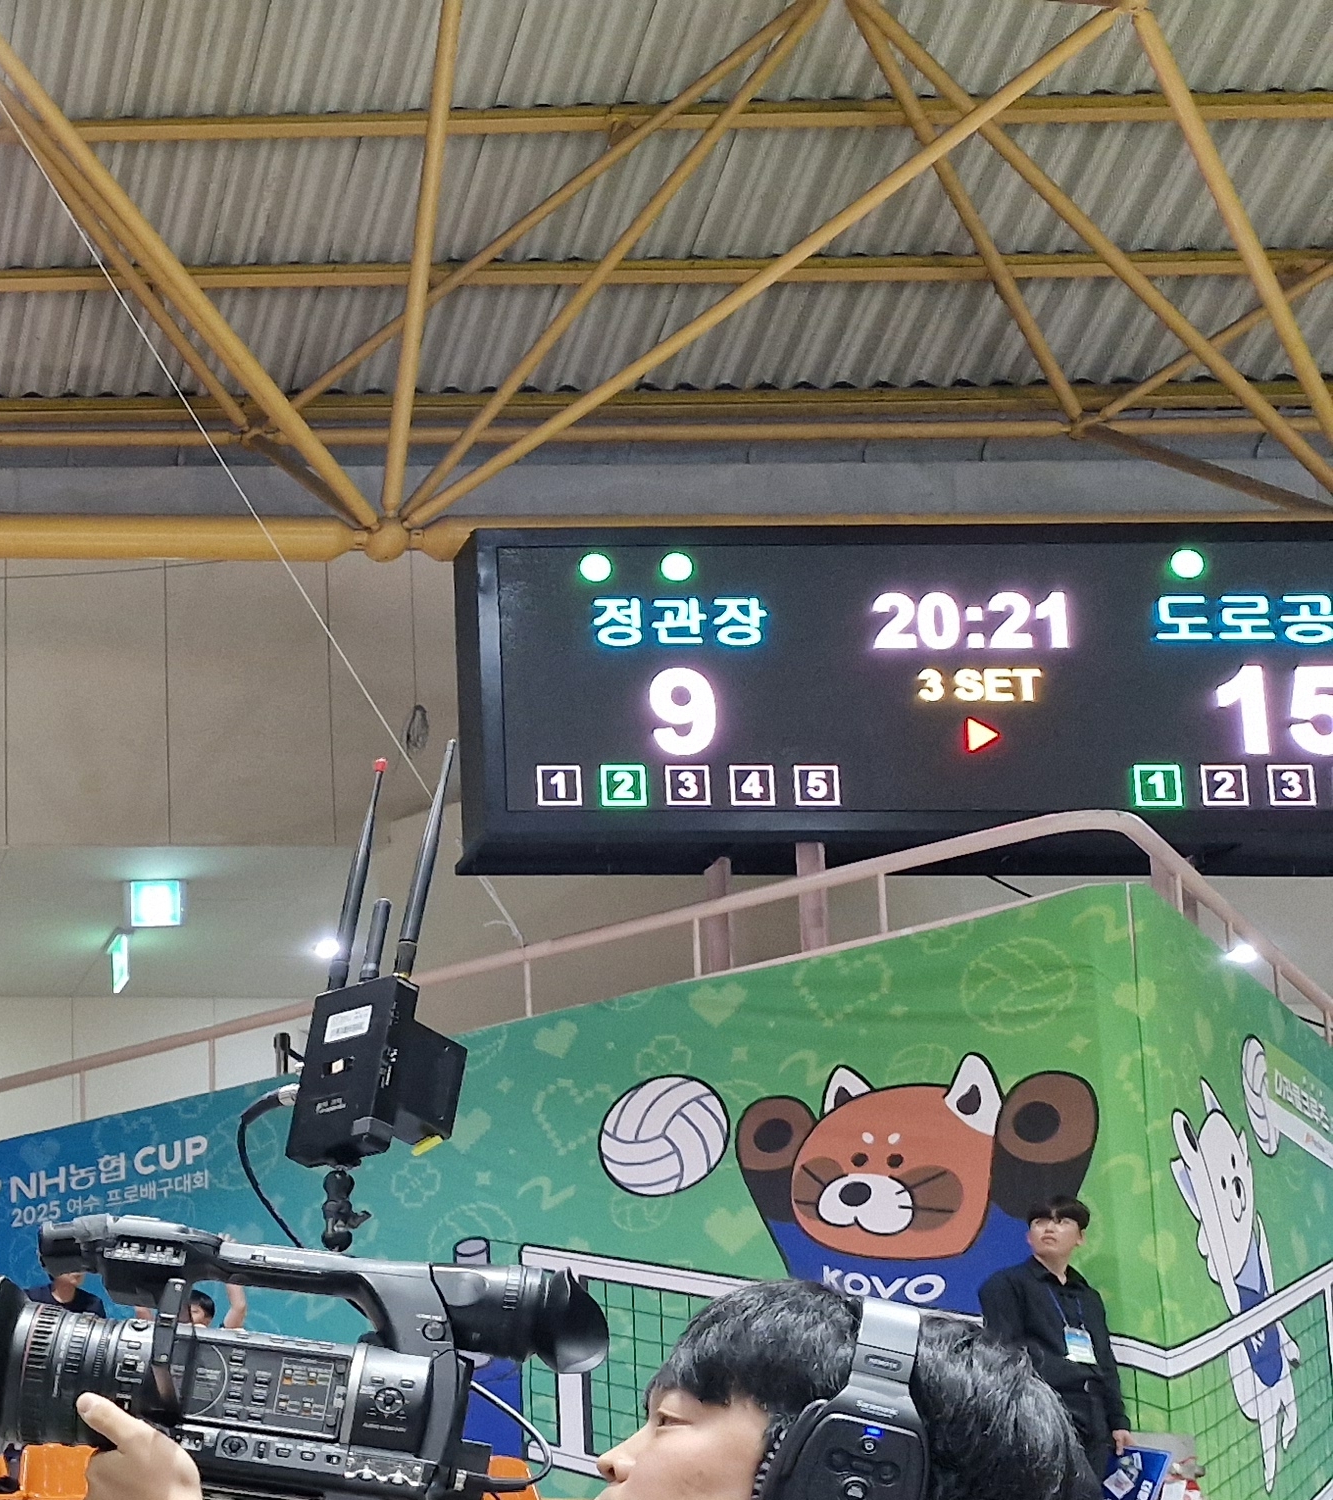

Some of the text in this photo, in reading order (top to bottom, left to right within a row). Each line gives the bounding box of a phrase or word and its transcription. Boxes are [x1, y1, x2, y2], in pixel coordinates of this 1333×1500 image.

[592, 596, 768, 648] 정관장
[869, 591, 1073, 651] 20:21
[1154, 594, 1333, 645] 도로공
[648, 666, 717, 757] 9
[917, 668, 1042, 704] 3 SET
[1214, 664, 1333, 758] 15
[549, 771, 828, 799] 1 2 3 4 5
[1146, 770, 1303, 799] 1 2 3
[9, 1134, 209, 1204] NH농협 CUP
[10, 1169, 211, 1229] 2025 여수 프로배구대회
[821, 1264, 947, 1304] KOVO
